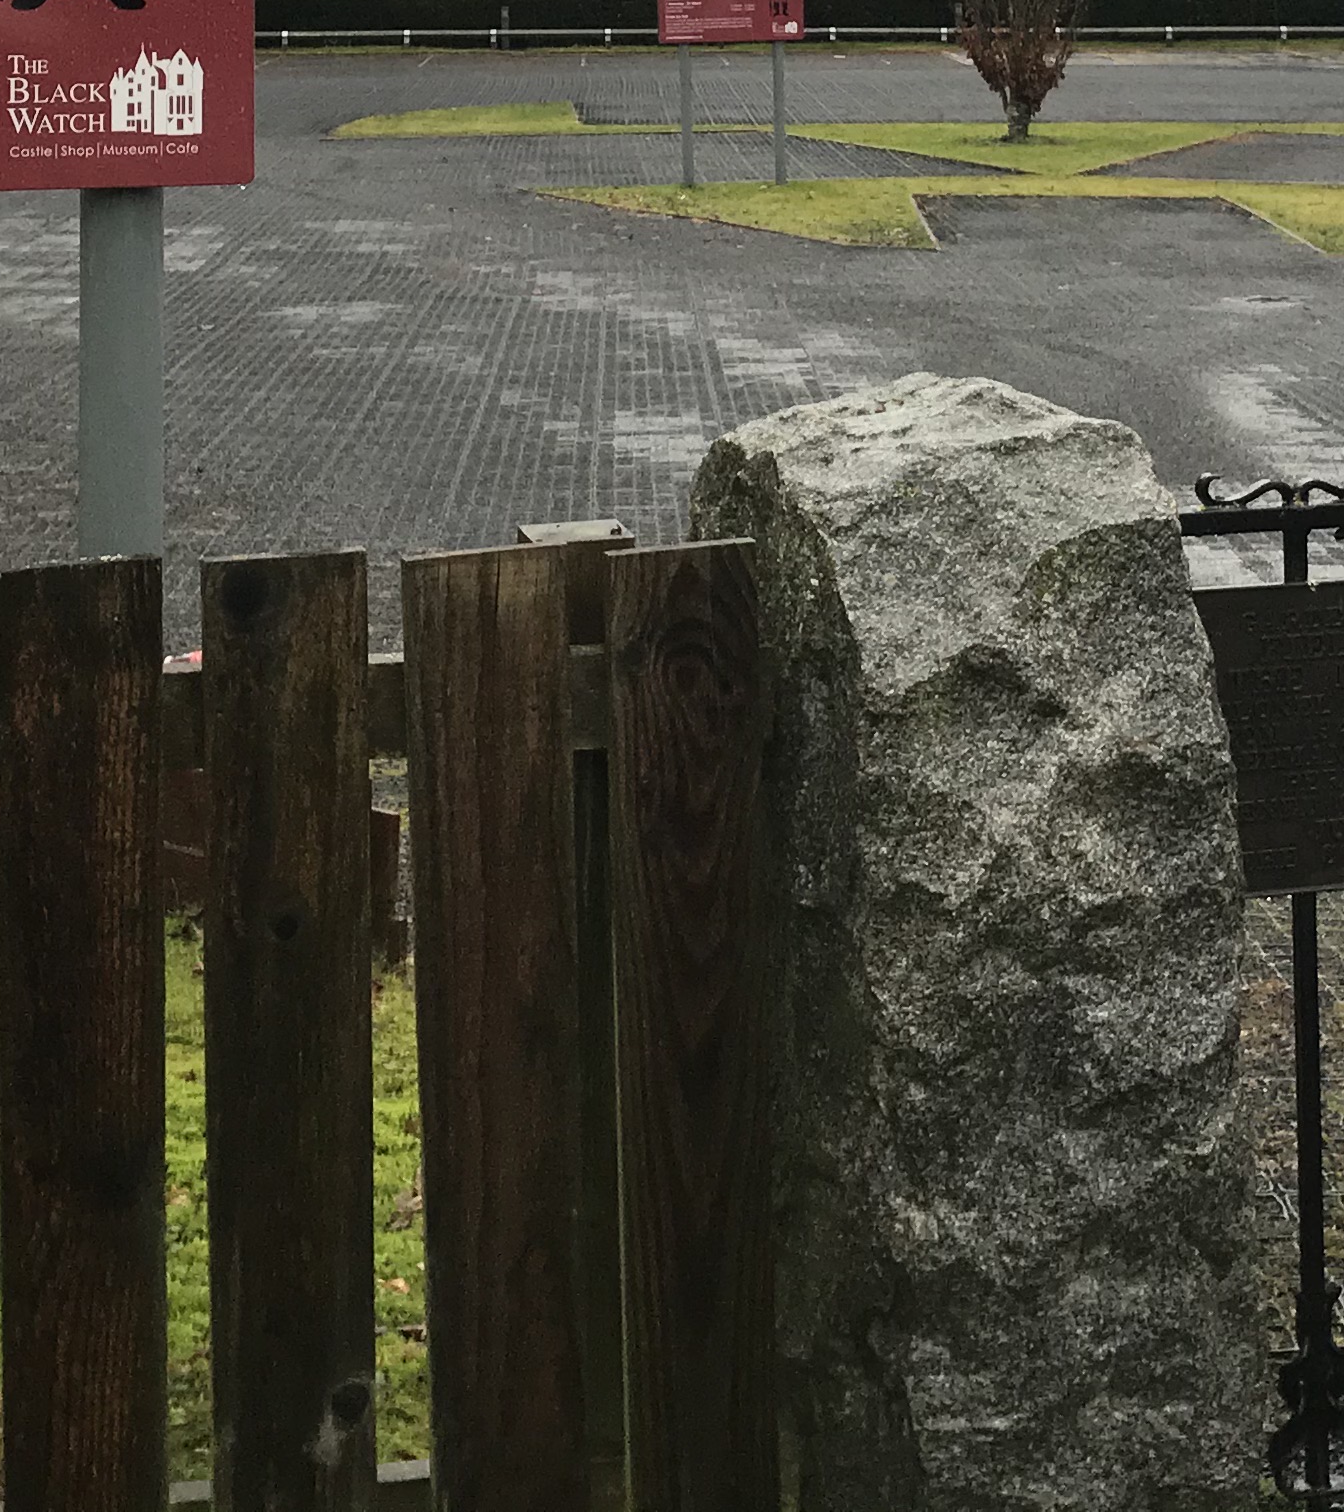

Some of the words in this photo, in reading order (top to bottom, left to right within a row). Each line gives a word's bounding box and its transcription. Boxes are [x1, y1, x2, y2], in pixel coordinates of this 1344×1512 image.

[7, 54, 49, 75] THE
[7, 76, 107, 104] BLACK
[6, 107, 106, 134] WATCH
